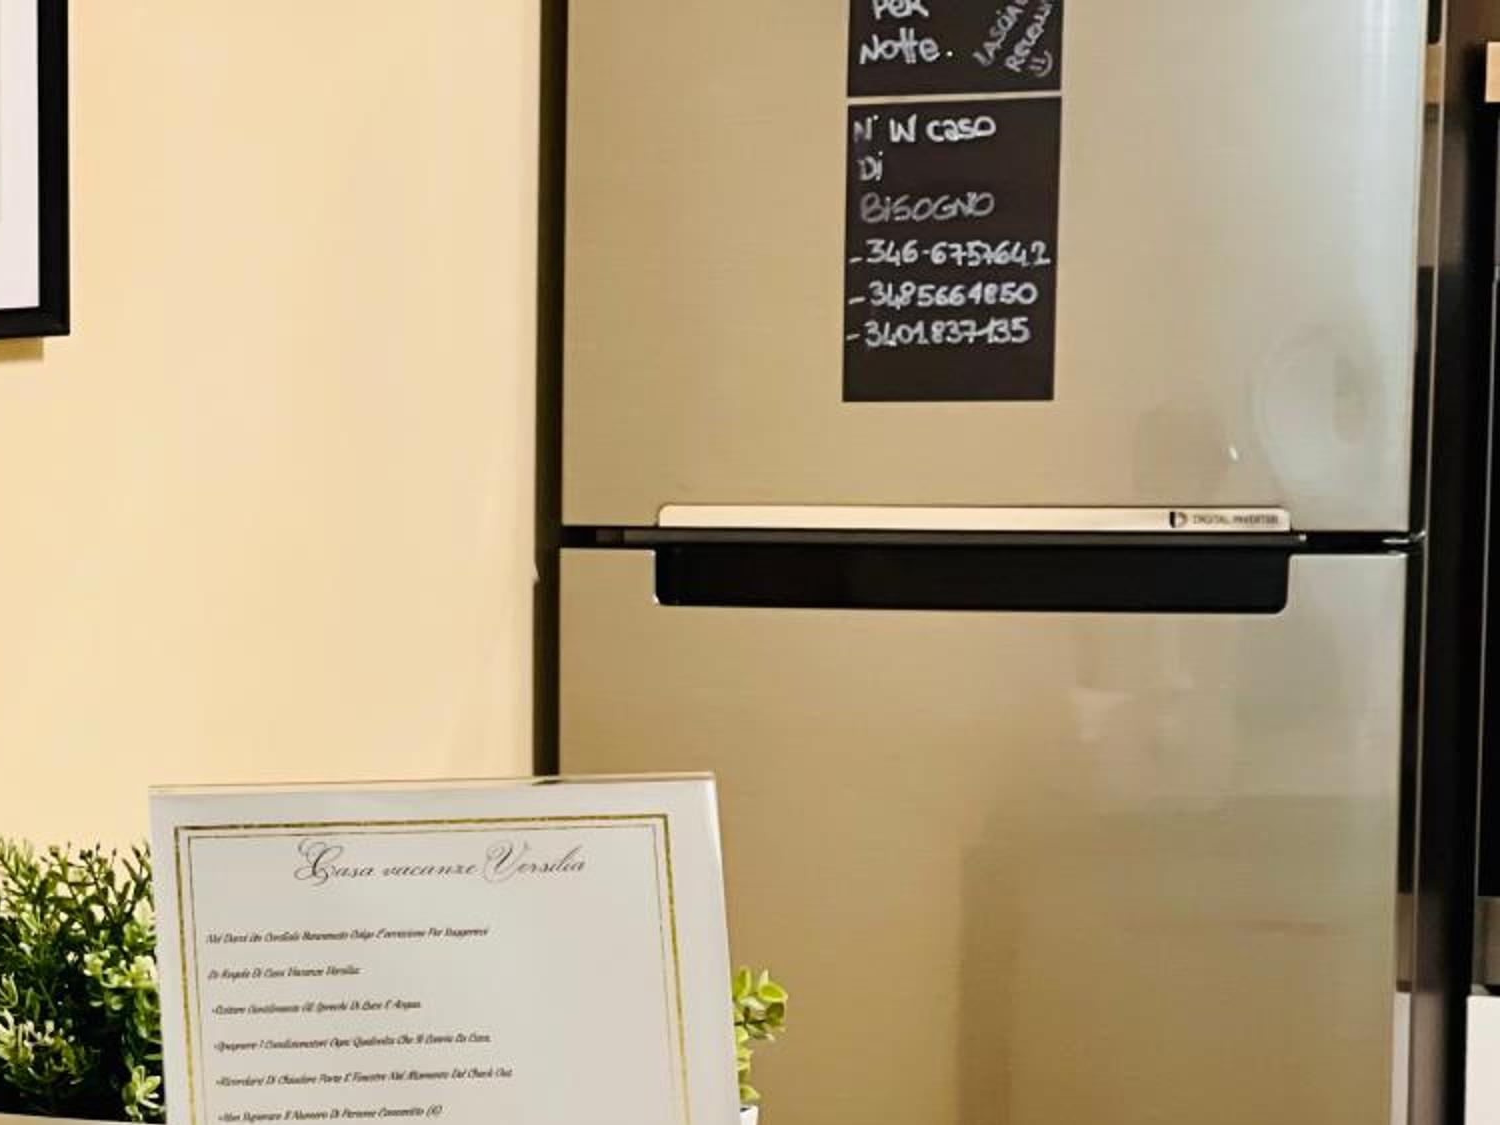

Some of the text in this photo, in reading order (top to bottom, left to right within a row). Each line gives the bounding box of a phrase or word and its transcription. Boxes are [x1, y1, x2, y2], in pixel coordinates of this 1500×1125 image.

[294, 838, 585, 887] Casa vacanze Versilia
